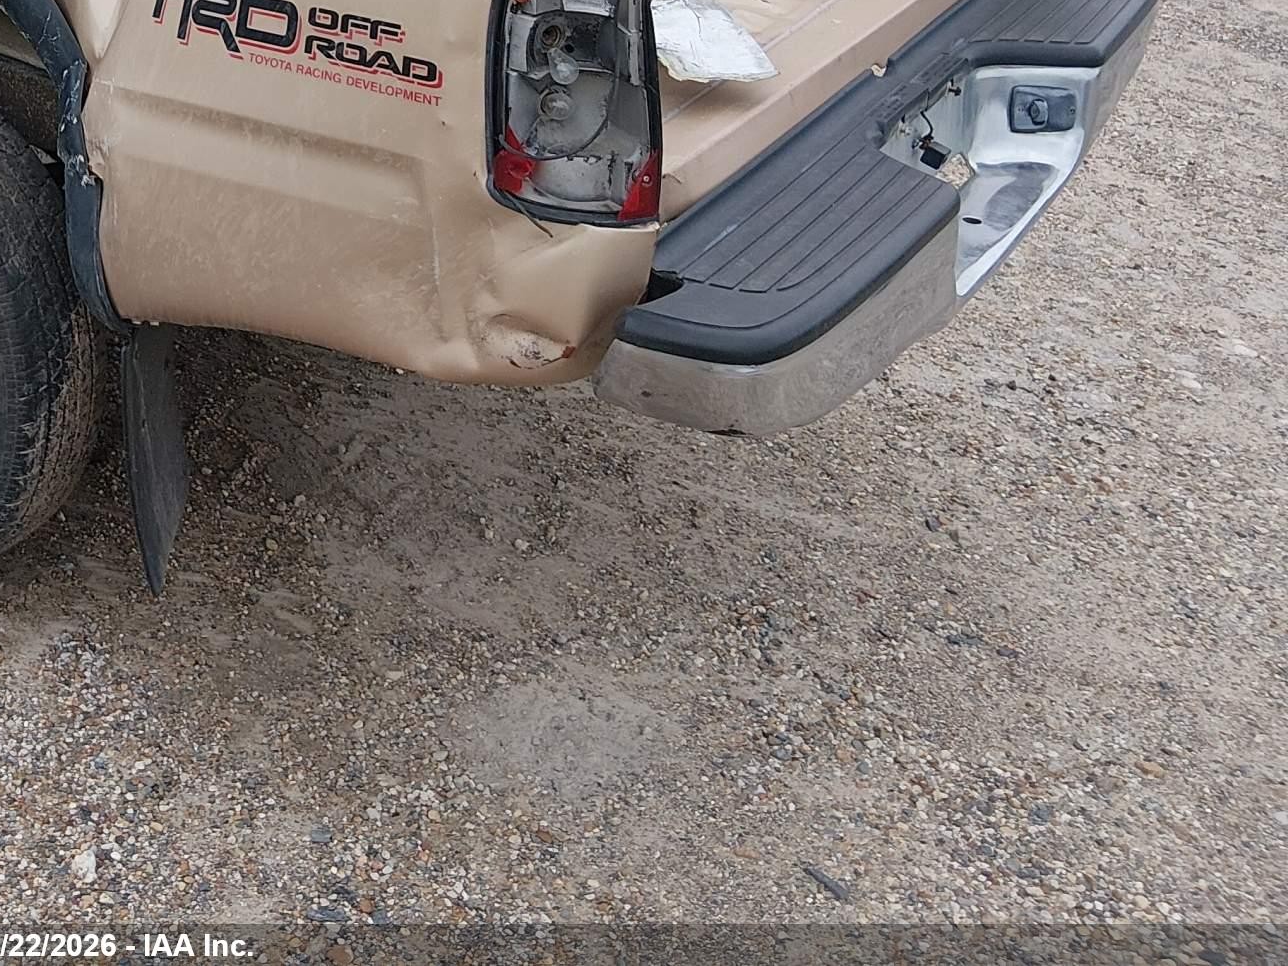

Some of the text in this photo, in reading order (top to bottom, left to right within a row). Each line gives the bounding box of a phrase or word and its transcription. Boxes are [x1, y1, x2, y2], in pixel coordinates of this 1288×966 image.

[307, 6, 406, 45] OFF
[249, 52, 443, 108] TOYOTA RACING DEVELOPMENT
[304, 35, 443, 89] ROAD
